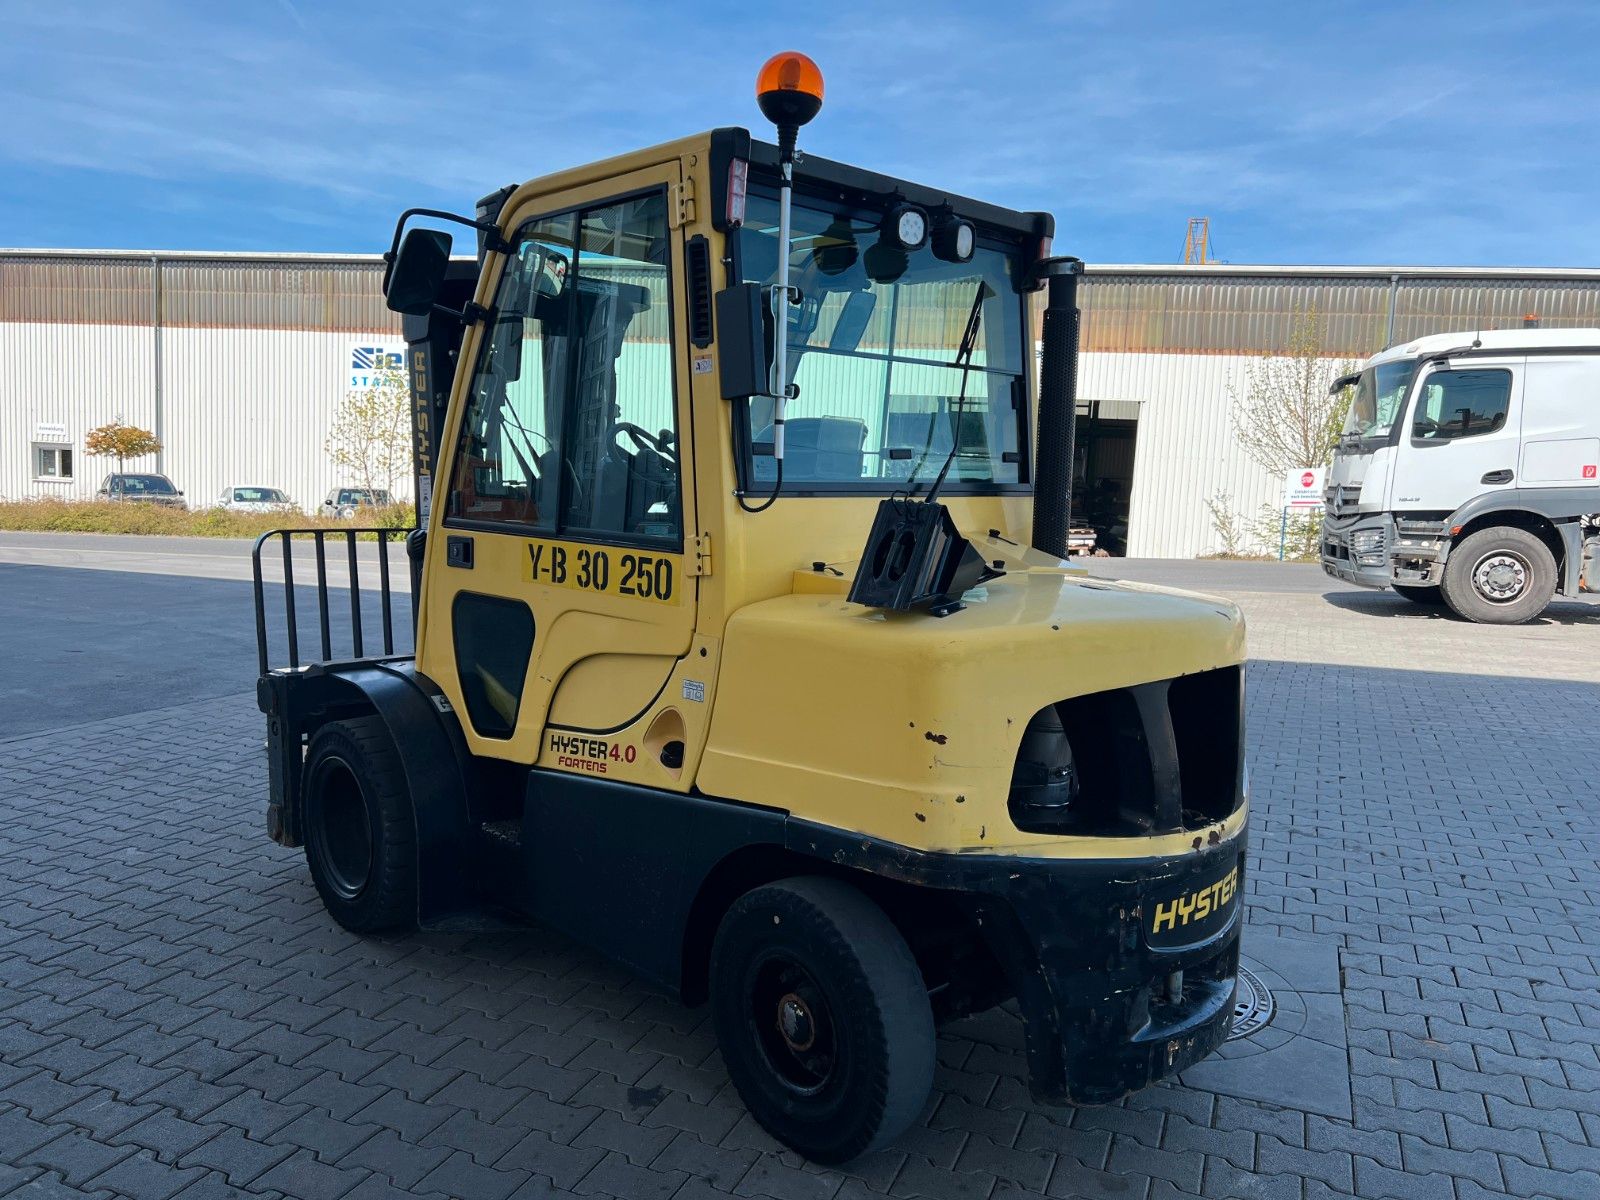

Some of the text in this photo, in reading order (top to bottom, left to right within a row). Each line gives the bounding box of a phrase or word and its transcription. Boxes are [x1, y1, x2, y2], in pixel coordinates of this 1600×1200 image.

[414, 351, 431, 477] HYSTER
[528, 543, 673, 601] Y-B 30 250
[550, 734, 637, 764] HYSTER 4.0
[558, 756, 608, 774] FORTENS
[1152, 865, 1238, 934] HYSTER
